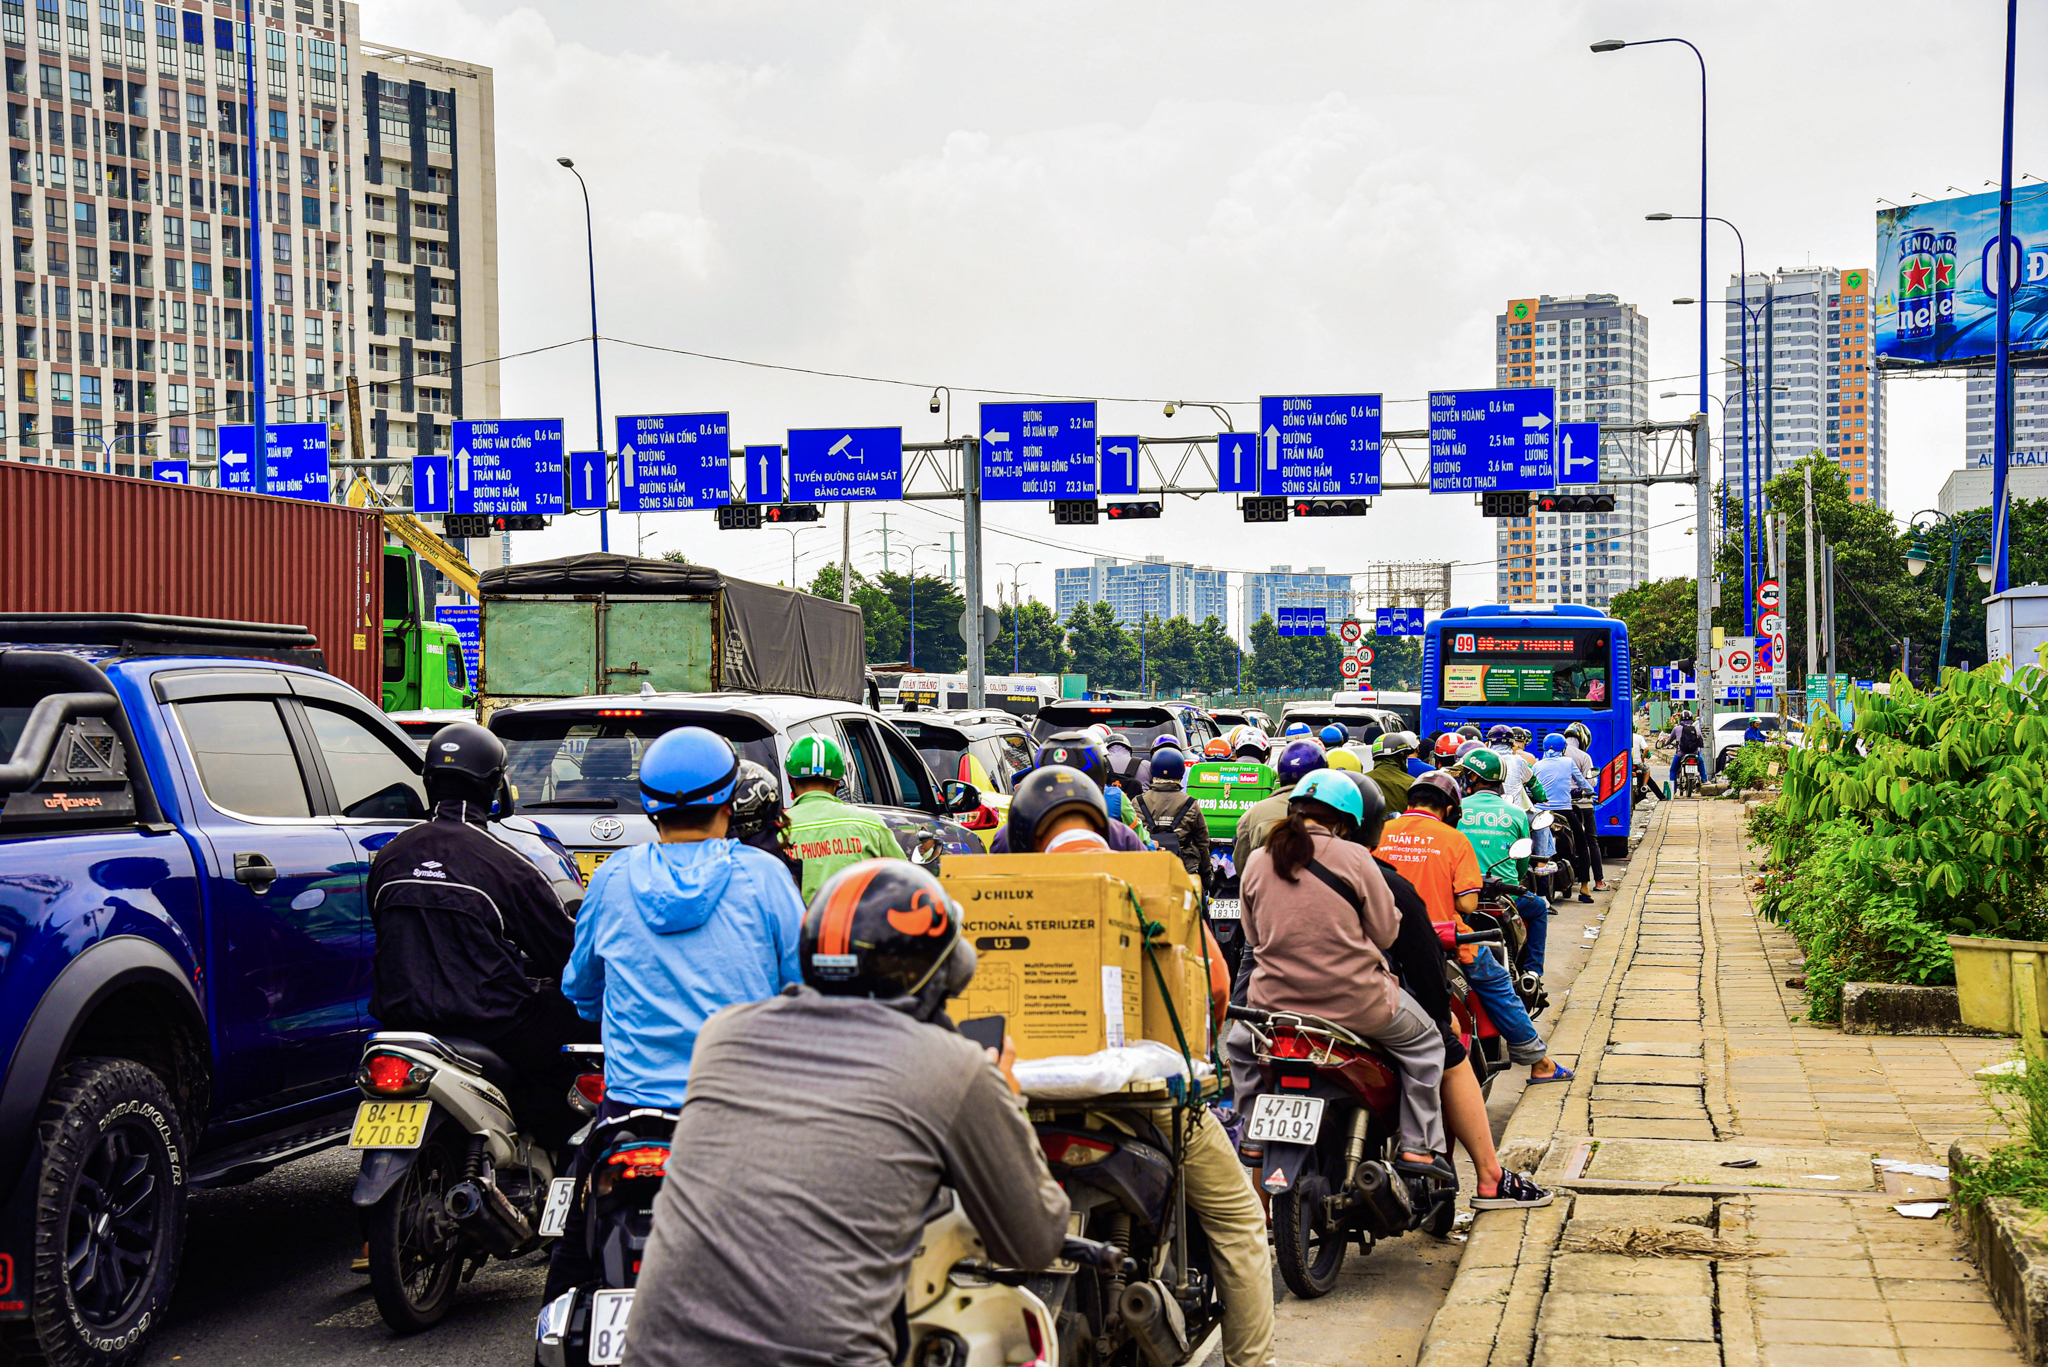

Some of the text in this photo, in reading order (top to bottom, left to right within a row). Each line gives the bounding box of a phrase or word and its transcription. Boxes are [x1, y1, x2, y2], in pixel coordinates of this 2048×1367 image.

[1283, 397, 1312, 410] ĐƯỜNG
[1432, 392, 1456, 406] ĐƯỜNG
[1350, 406, 1379, 418] 0,6 km
[1489, 401, 1514, 413] 0,6 km
[1023, 408, 1042, 422] ĐƯỜNG
[1307, 412, 1323, 425] VĂN
[1325, 410, 1347, 425] CỐNG
[1431, 407, 1485, 422] NGUYỄN HOÀNG
[472, 421, 498, 434] ĐƯỜNG
[637, 417, 664, 430] ĐƯỜNG
[700, 424, 726, 435] 0,6 km
[1070, 418, 1093, 429] 3,2 km
[535, 430, 560, 441] 0,6 km
[660, 431, 674, 444] VĂN
[677, 428, 697, 443] CỐNG
[1032, 424, 1046, 437] XUÂN
[1048, 426, 1059, 438] HỢP
[1282, 430, 1311, 444] ĐƯỜNG
[1432, 426, 1456, 440] ĐƯỜNG
[303, 439, 325, 450] 3,2 km
[495, 436, 509, 449] VĂN
[511, 434, 531, 448] CỐNG
[1489, 435, 1514, 447] 2,5 km
[1524, 431, 1549, 445] ĐƯỜNG
[267, 445, 293, 459] XUÂN HỢP
[1023, 444, 1042, 457] ĐƯỜNG
[1350, 440, 1378, 451] 3,3 km
[1452, 442, 1466, 456] NÃO
[473, 452, 499, 466] ĐƯỜNG
[638, 448, 665, 462] ĐƯỜNG
[992, 451, 1002, 462] CAO
[1070, 453, 1094, 465] 4,5 km
[1307, 446, 1324, 459] NÃO
[1524, 449, 1548, 461] LƯƠNG
[535, 462, 561, 473] 3,3 km
[701, 456, 727, 467] 3,3 km
[1023, 459, 1068, 472] VÀNH ĐAI ĐÔNG
[1433, 459, 1461, 473] ĐƯỜNG
[1488, 460, 1513, 472] 3,6 km
[496, 468, 511, 480] NÃO
[661, 463, 676, 476] NÃO
[794, 470, 897, 482] TUYẾN ĐƯỜNG GIÁM SÁT
[1282, 463, 1311, 477] ĐƯỜNG
[1520, 461, 1552, 478] ĐỊNH CỦA
[229, 472, 239, 483] CAO
[305, 472, 327, 484] 4,5 km
[1350, 473, 1378, 485] 5,7 km
[1433, 474, 1496, 489] NGUYỄN CƠ THẠCH
[473, 484, 500, 498] ĐƯỜNG
[639, 481, 666, 494] ĐƯỜNG
[815, 484, 876, 497] BẰNG CAMERA
[1022, 478, 1056, 494] QUỐC LỘ 51
[1066, 481, 1094, 493] 23,3 km
[1282, 478, 1340, 493] SÔNG SÀI GÒN
[536, 493, 562, 504] 5,7 km
[702, 488, 728, 499] 5,7 km
[473, 499, 527, 512] SÔNG SÀI GÒN
[639, 494, 693, 508] SÔNG SÀI GÒN
[1457, 636, 1473, 651] 99
[1360, 651, 1368, 660] 60
[1345, 663, 1355, 672] 80
[1469, 756, 1487, 770] Grab
[1219, 799, 1237, 809] 3636
[1461, 808, 1513, 828] Grab
[1414, 836, 1420, 844] P
[1427, 836, 1434, 844] T
[801, 840, 831, 860] PHUONG
[985, 890, 1034, 900] CHILUX
[1215, 901, 1238, 909] 59-C3
[1214, 909, 1240, 918] 183.10
[1027, 919, 1095, 930] STERILIZER
[994, 938, 1012, 949] U3
[367, 1104, 417, 1123] 84-L1
[1265, 1099, 1311, 1119] 47-D1
[355, 1126, 419, 1144] 470.63
[1254, 1118, 1314, 1141] 510.92
